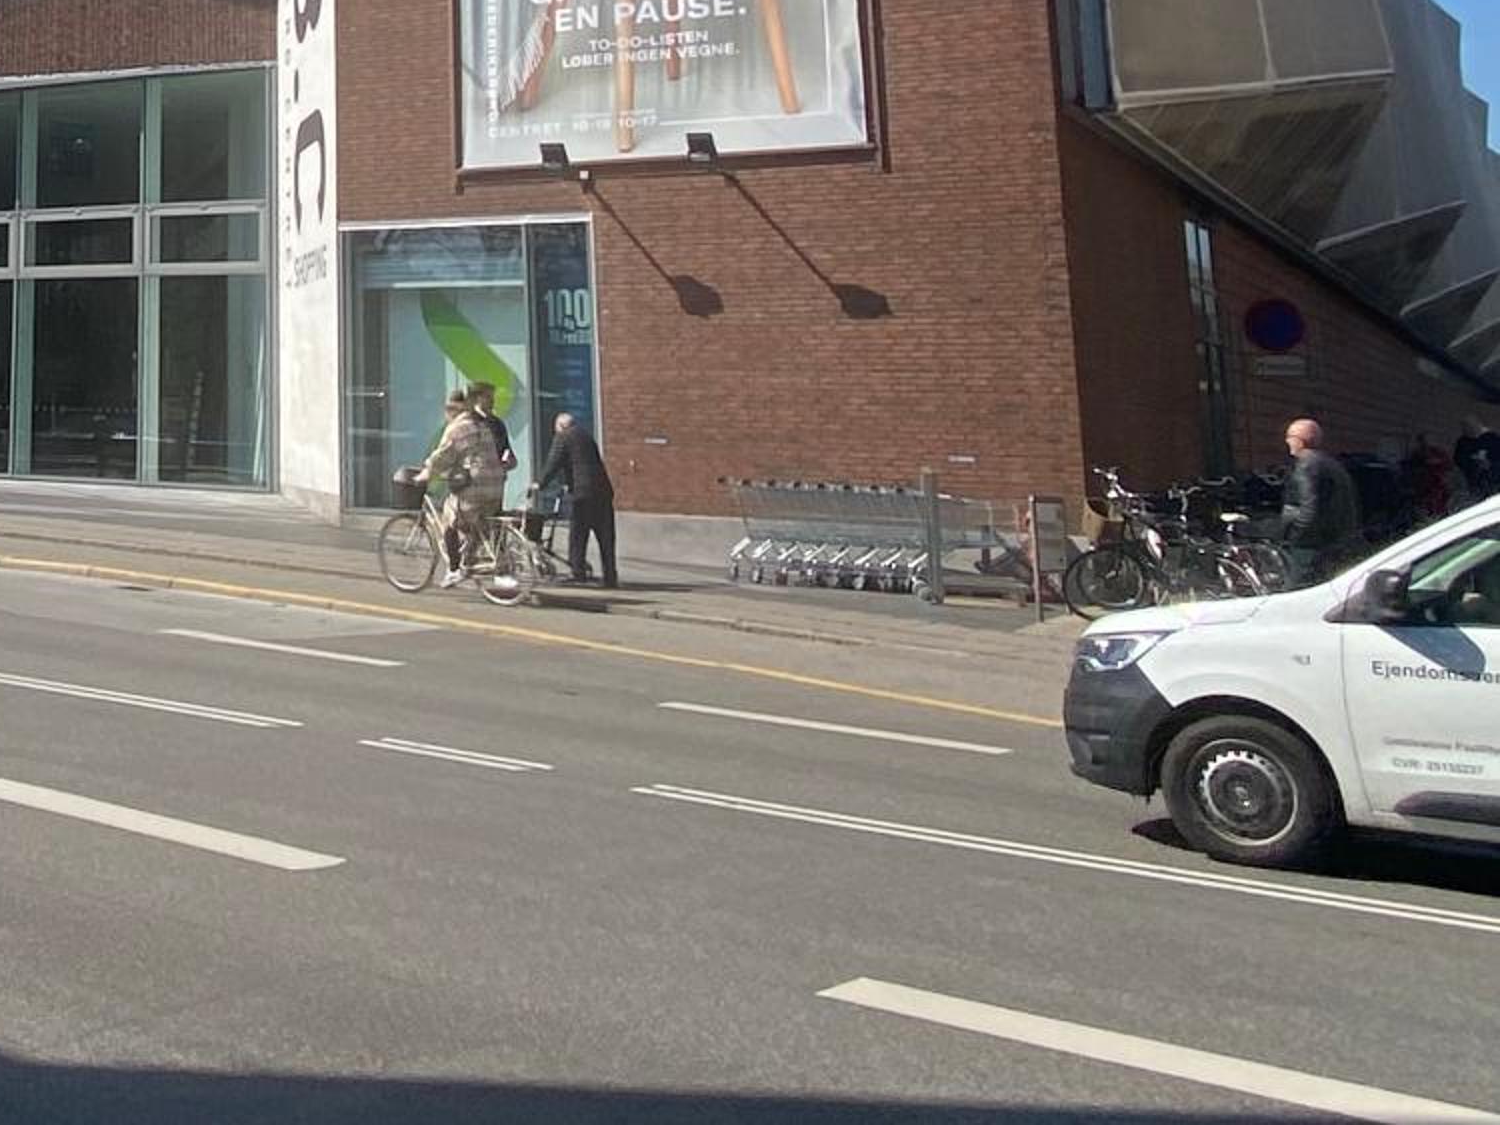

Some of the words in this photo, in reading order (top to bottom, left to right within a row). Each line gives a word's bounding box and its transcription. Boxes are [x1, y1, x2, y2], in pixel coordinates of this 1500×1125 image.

[555, 6, 598, 32] EN
[589, 30, 708, 52] TO-DO-LISTEN
[619, 47, 671, 63] INGEN
[677, 42, 740, 59] VEGNE.
